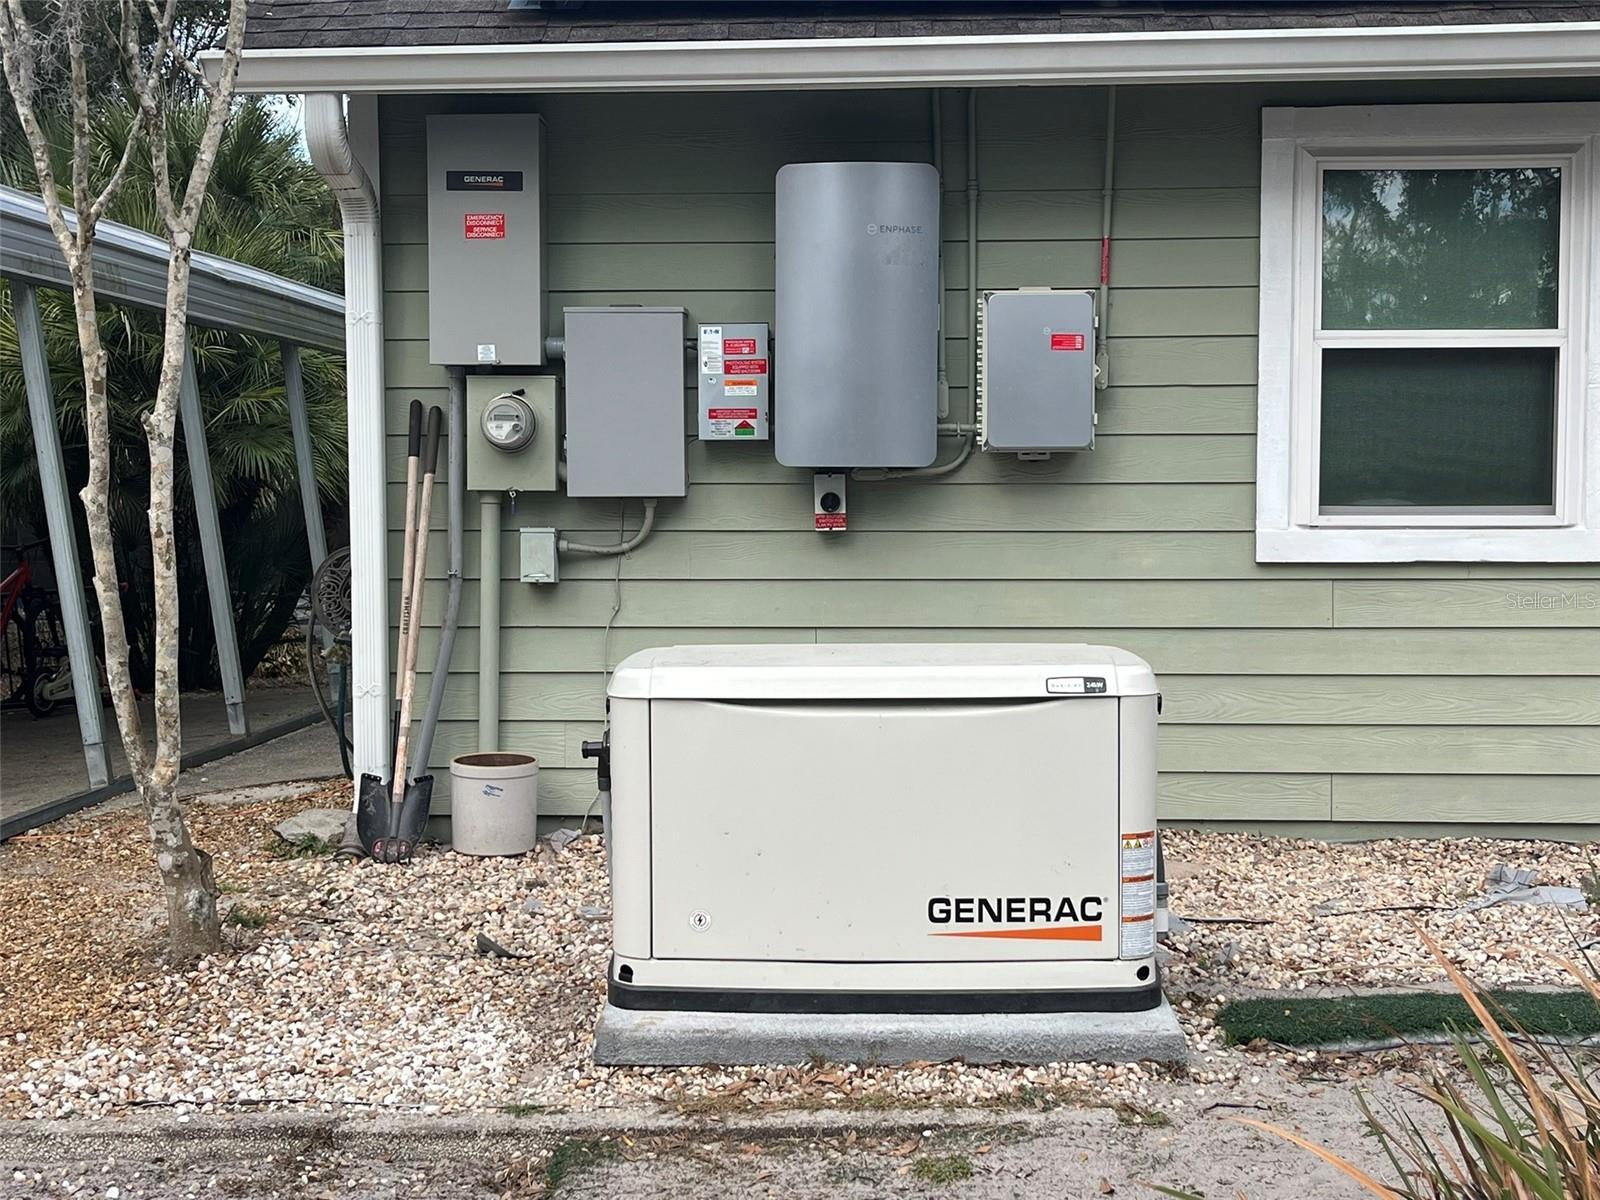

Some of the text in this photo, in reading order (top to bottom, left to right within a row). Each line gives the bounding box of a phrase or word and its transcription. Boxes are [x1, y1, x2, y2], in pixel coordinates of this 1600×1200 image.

[463, 175, 504, 183] GENERAC
[879, 225, 923, 234] ENPHASE
[927, 896, 1103, 924] GENERAC
